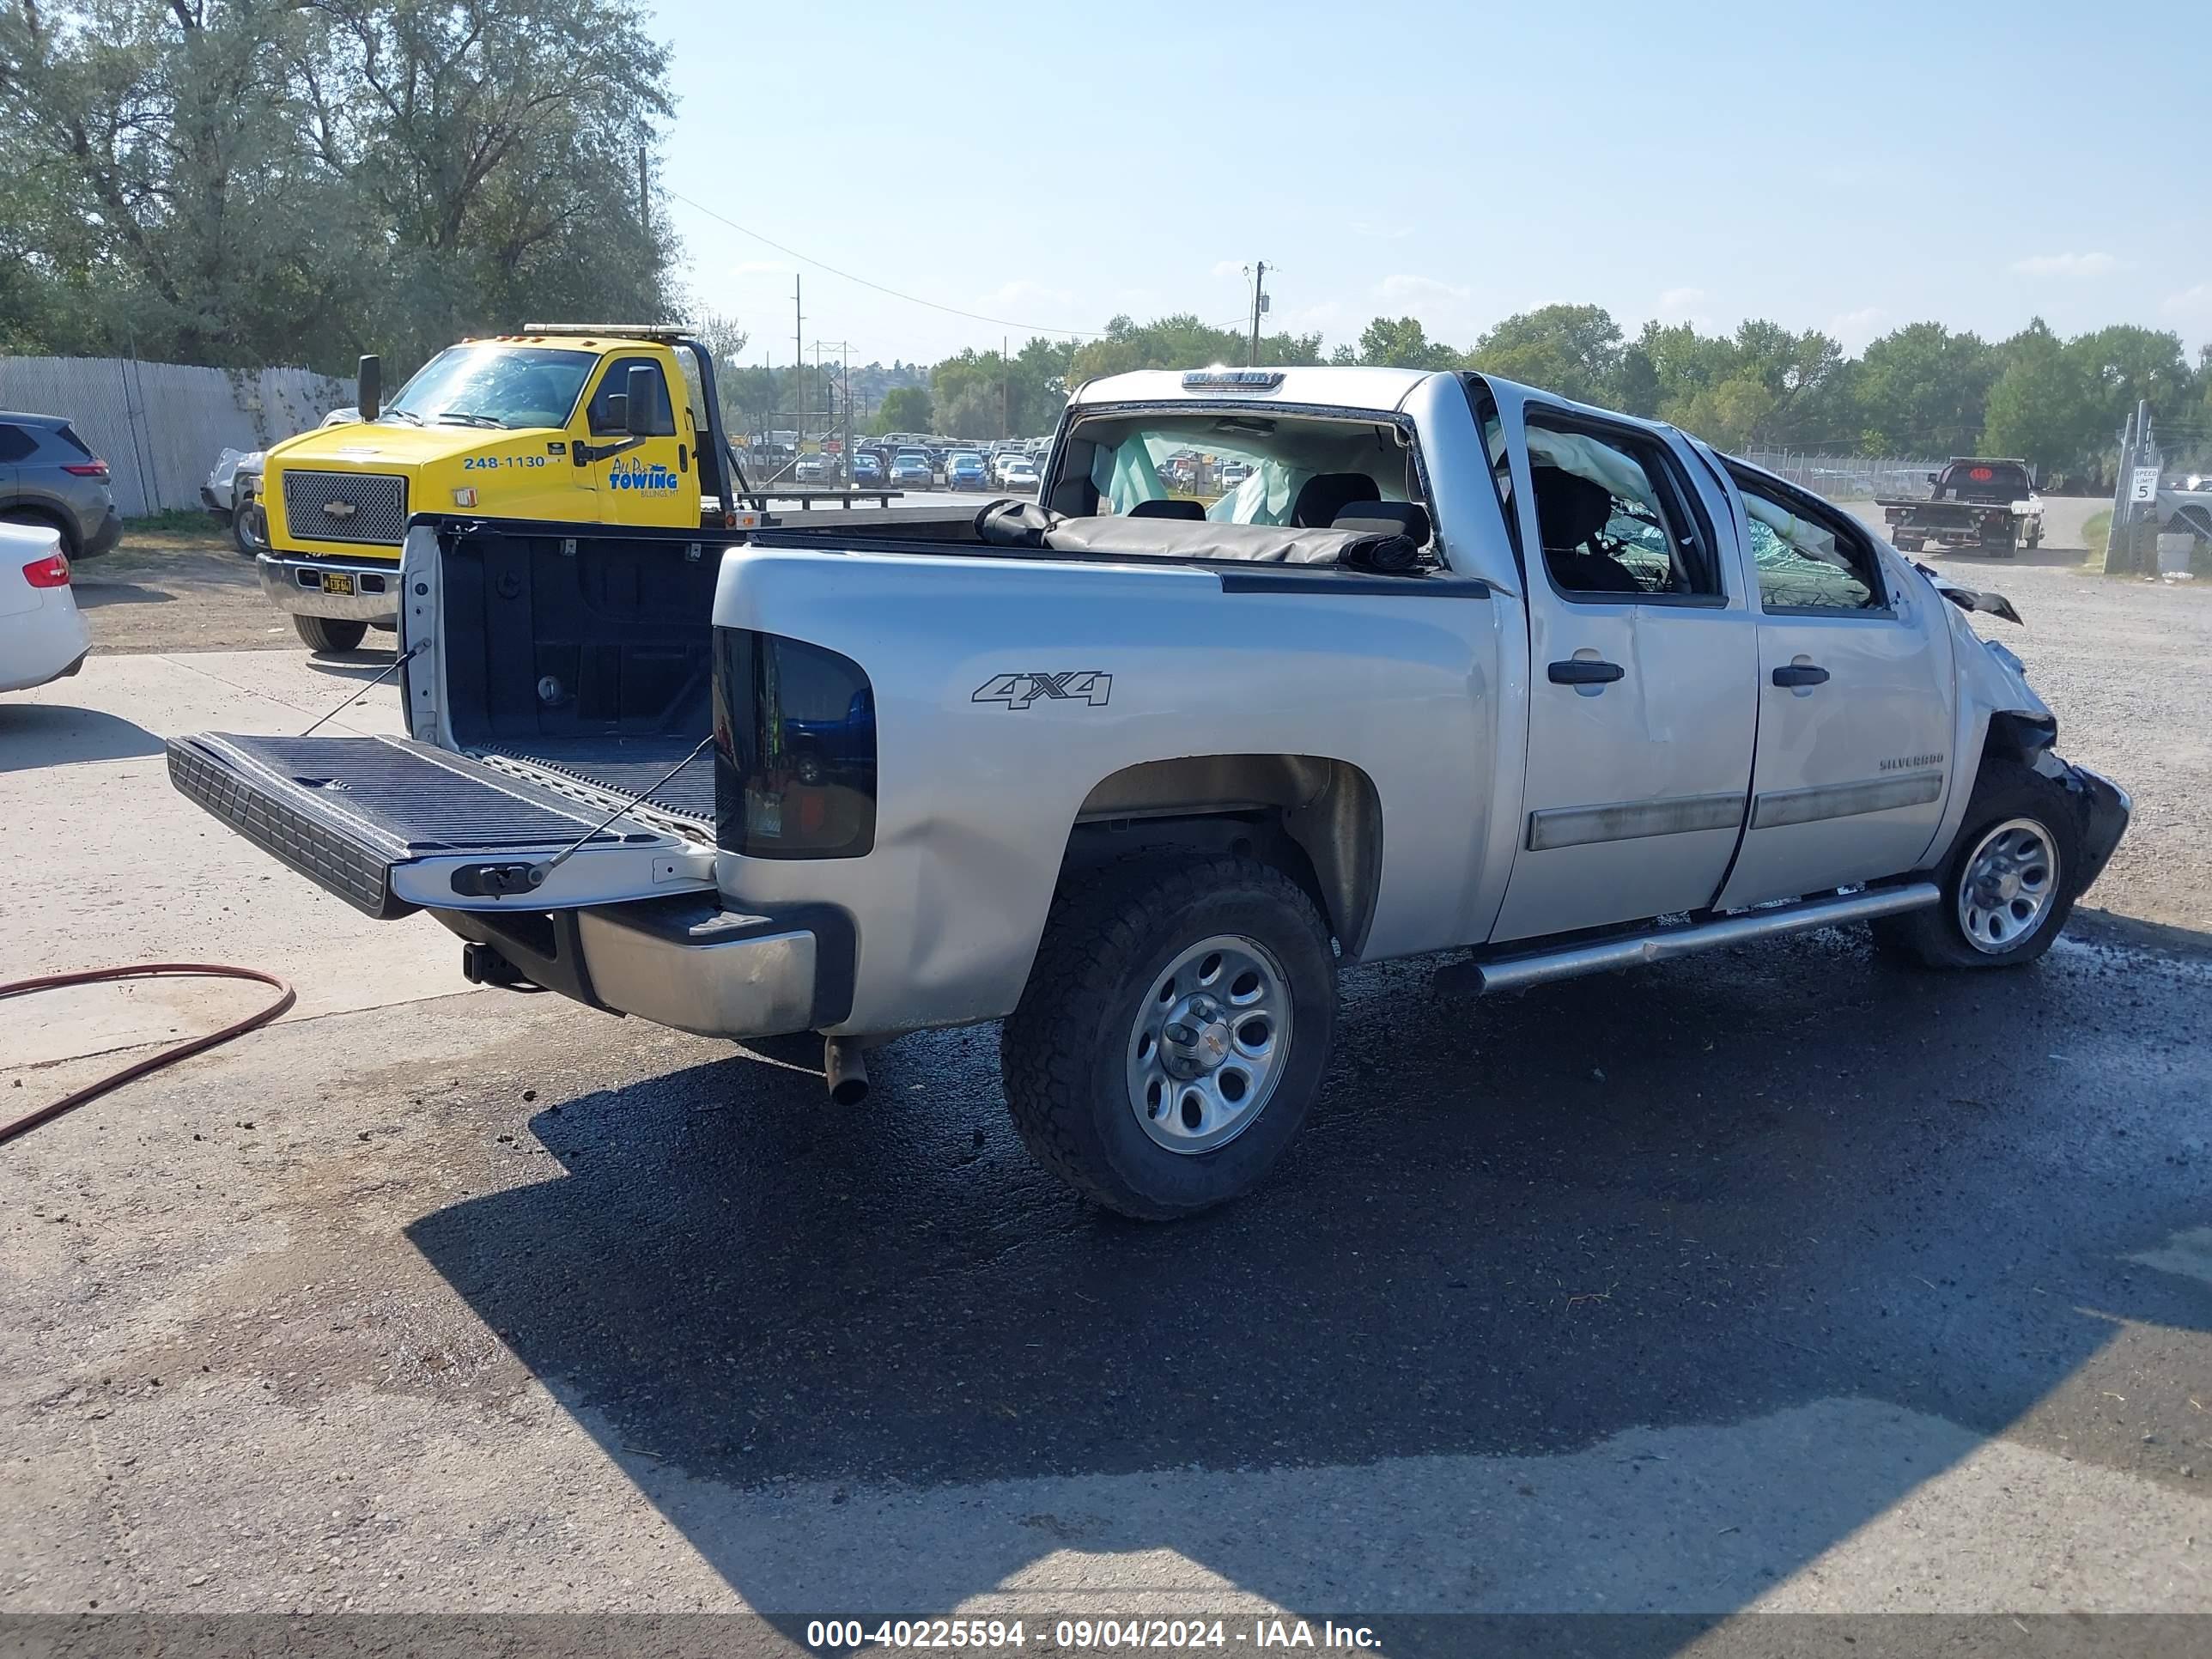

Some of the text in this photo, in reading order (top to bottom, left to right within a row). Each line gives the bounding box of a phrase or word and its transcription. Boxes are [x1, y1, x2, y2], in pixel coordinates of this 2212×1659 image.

[464, 456, 545, 471] 248-1130
[609, 473, 678, 489] TOWING
[2137, 485, 2148, 498] 5
[1879, 752, 1944, 770] SILVERADO
